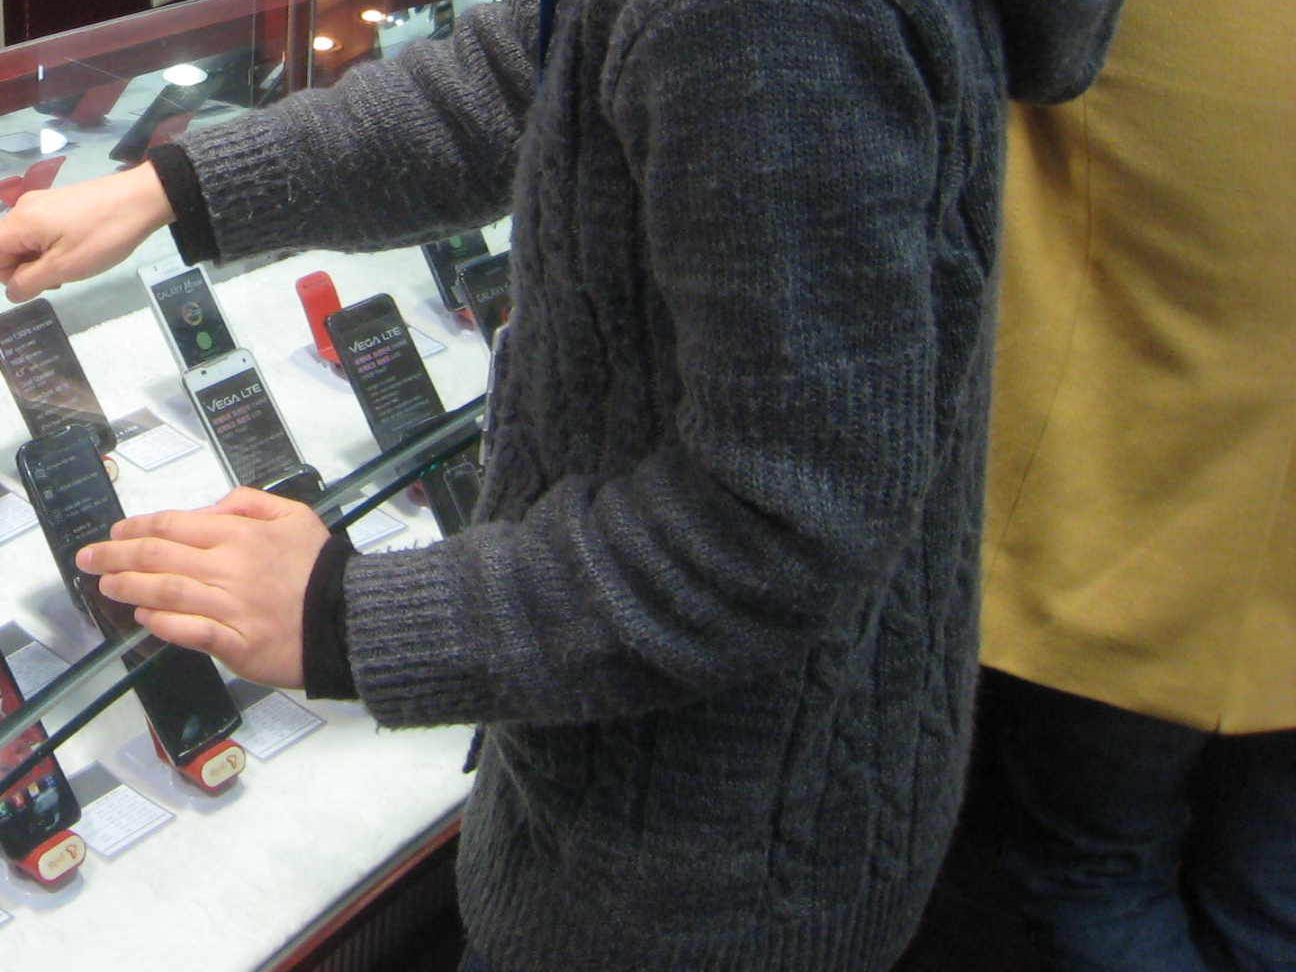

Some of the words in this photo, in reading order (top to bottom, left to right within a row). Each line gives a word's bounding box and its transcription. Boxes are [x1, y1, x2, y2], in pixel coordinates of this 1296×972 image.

[348, 336, 381, 353] VEGA
[380, 326, 402, 341] LTE
[205, 394, 241, 412] VEGA
[240, 383, 262, 399] LTE
